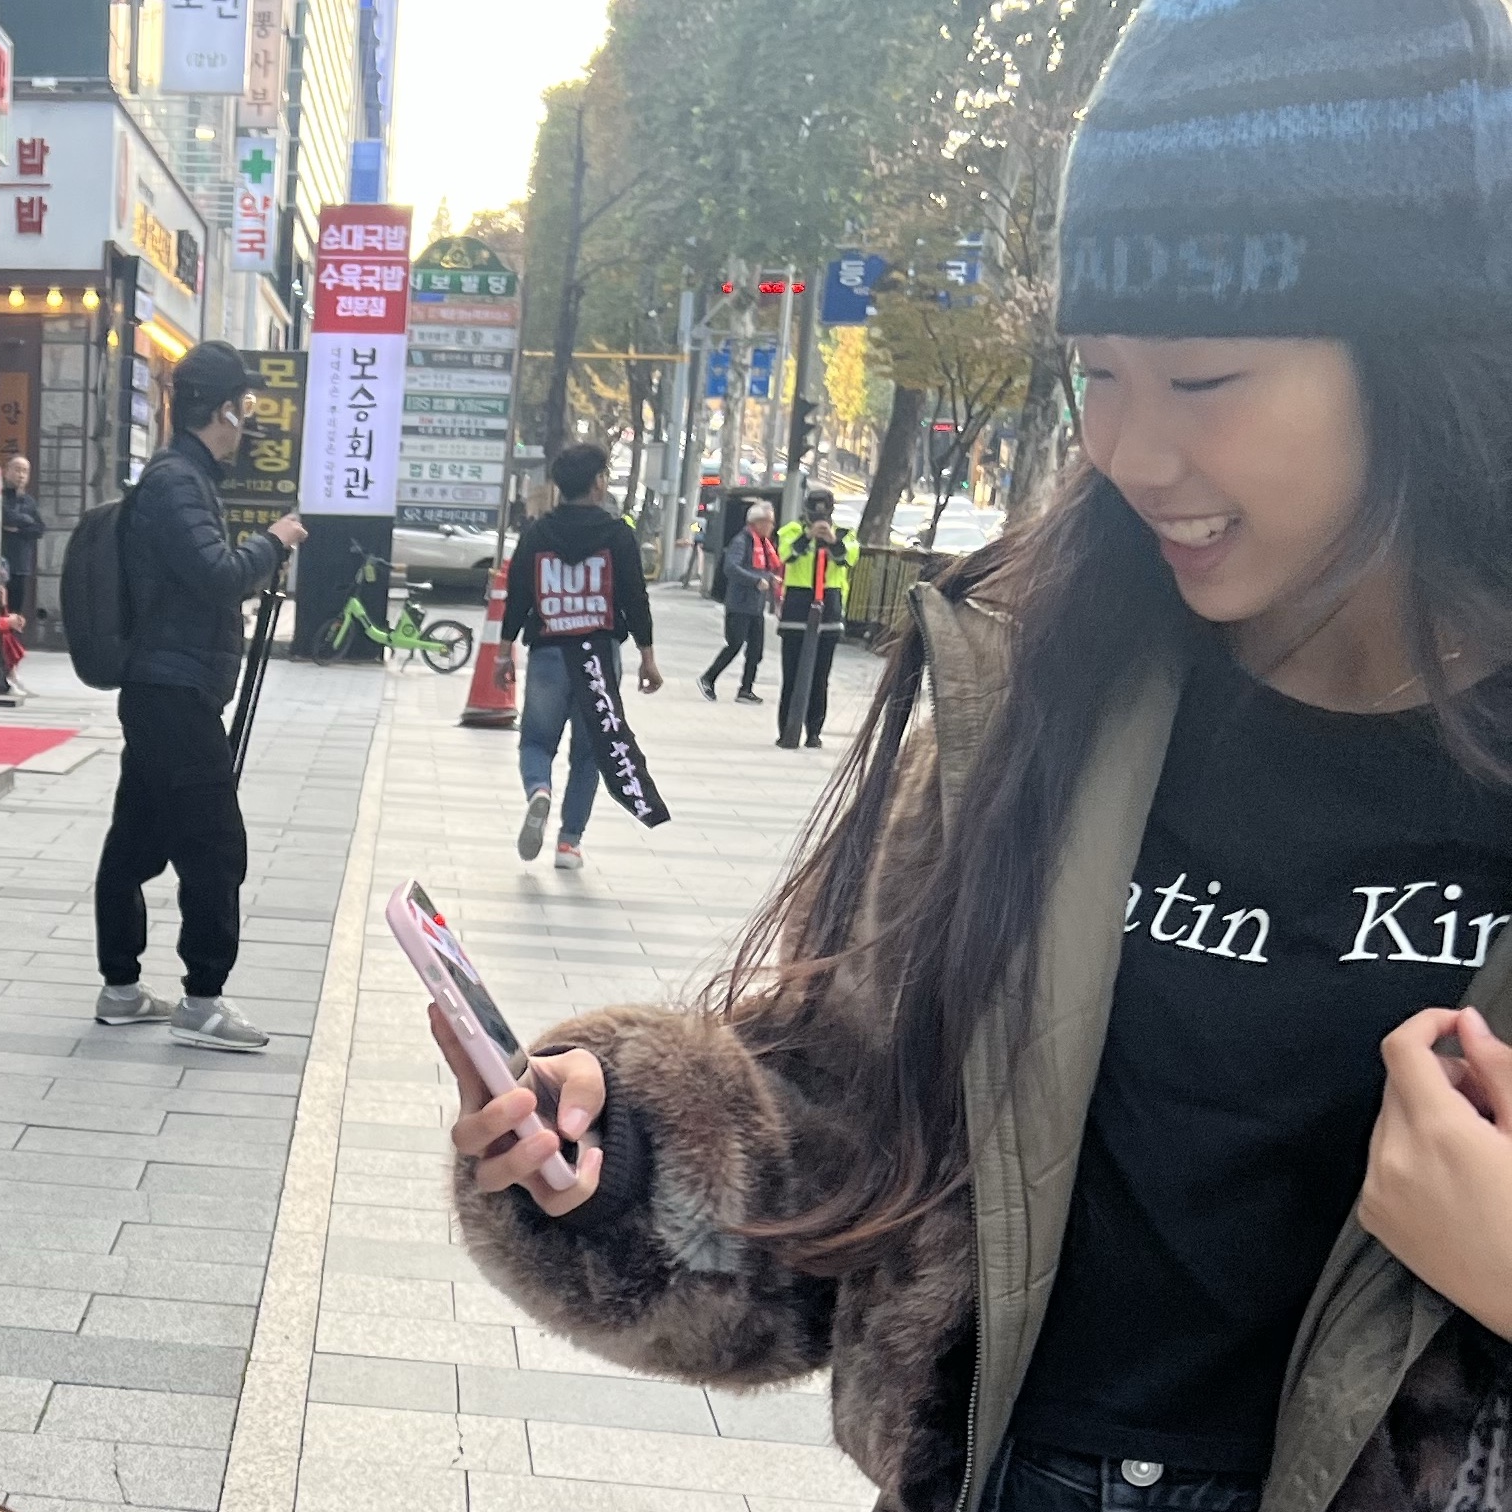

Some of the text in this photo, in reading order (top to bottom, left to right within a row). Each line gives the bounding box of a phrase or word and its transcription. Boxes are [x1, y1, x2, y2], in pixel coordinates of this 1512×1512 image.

[237, 192, 271, 261] 약국
[320, 224, 407, 251] 순대국밥
[318, 263, 407, 291] 수육국밥
[344, 347, 378, 500] 보승회관
